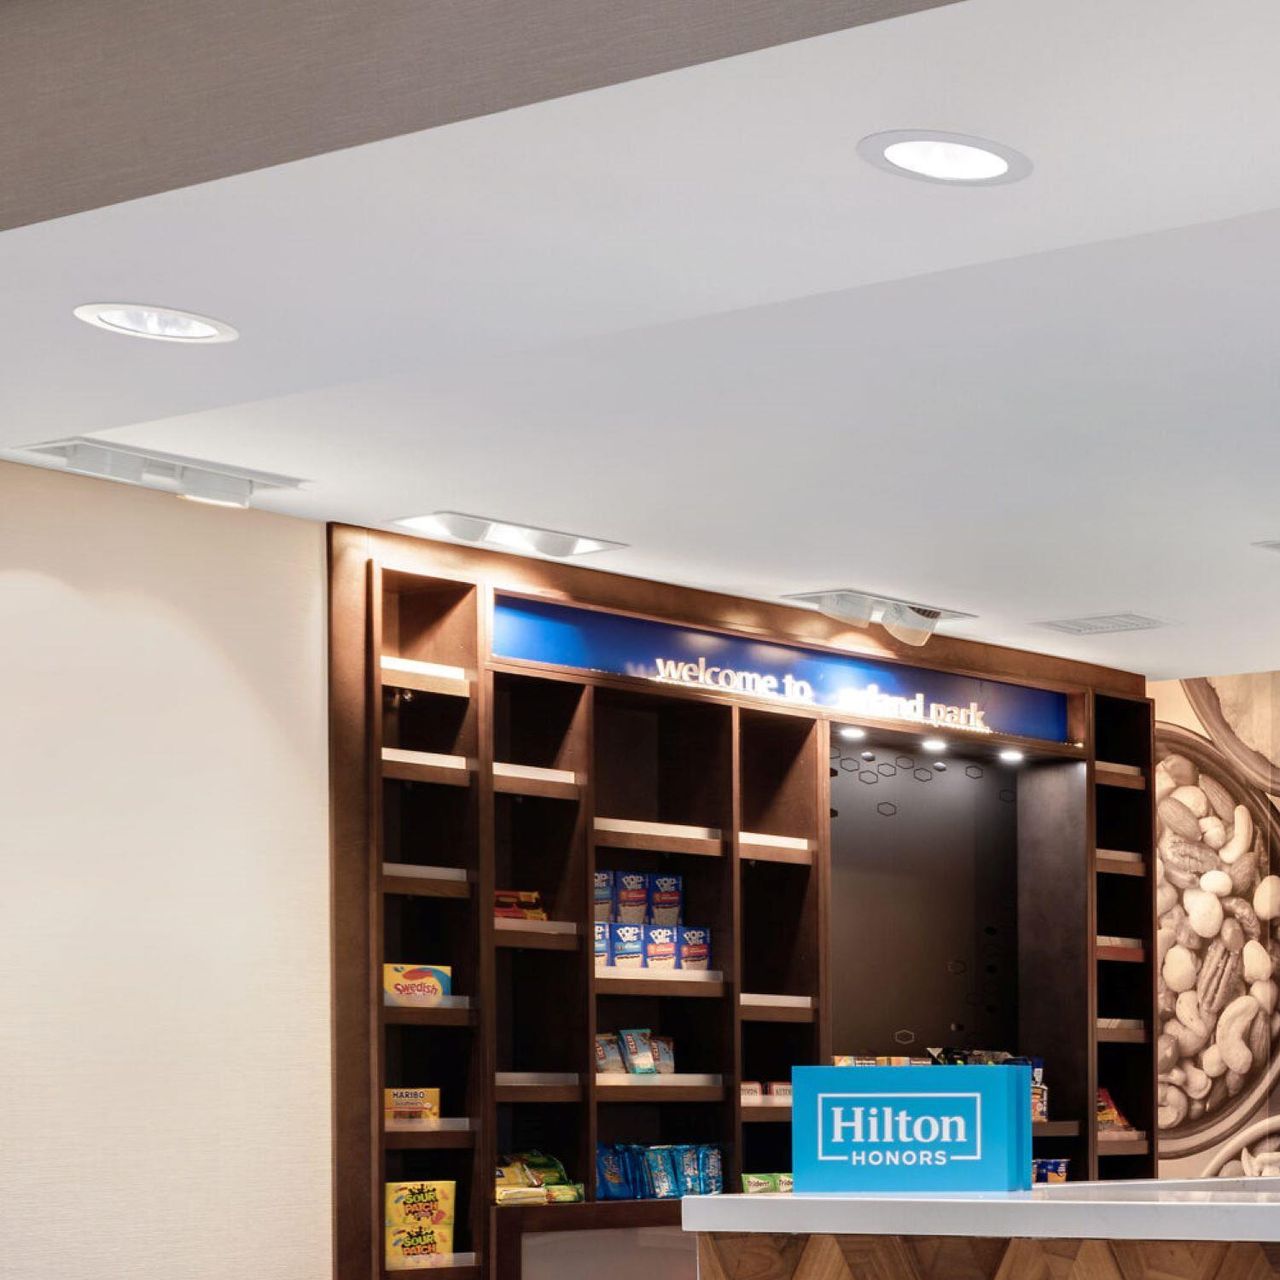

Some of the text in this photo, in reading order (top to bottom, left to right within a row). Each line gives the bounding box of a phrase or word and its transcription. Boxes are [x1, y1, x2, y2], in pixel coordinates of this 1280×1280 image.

[655, 657, 778, 695] welcome
[783, 673, 813, 703] to
[929, 702, 988, 728] park
[831, 1106, 967, 1143] Hilton
[851, 1150, 947, 1166] HONORS
[404, 1192, 437, 1204] SOUR
[404, 1202, 439, 1214] PATCH
[402, 1235, 435, 1247] SOUR
[402, 1243, 437, 1256] PATCH
